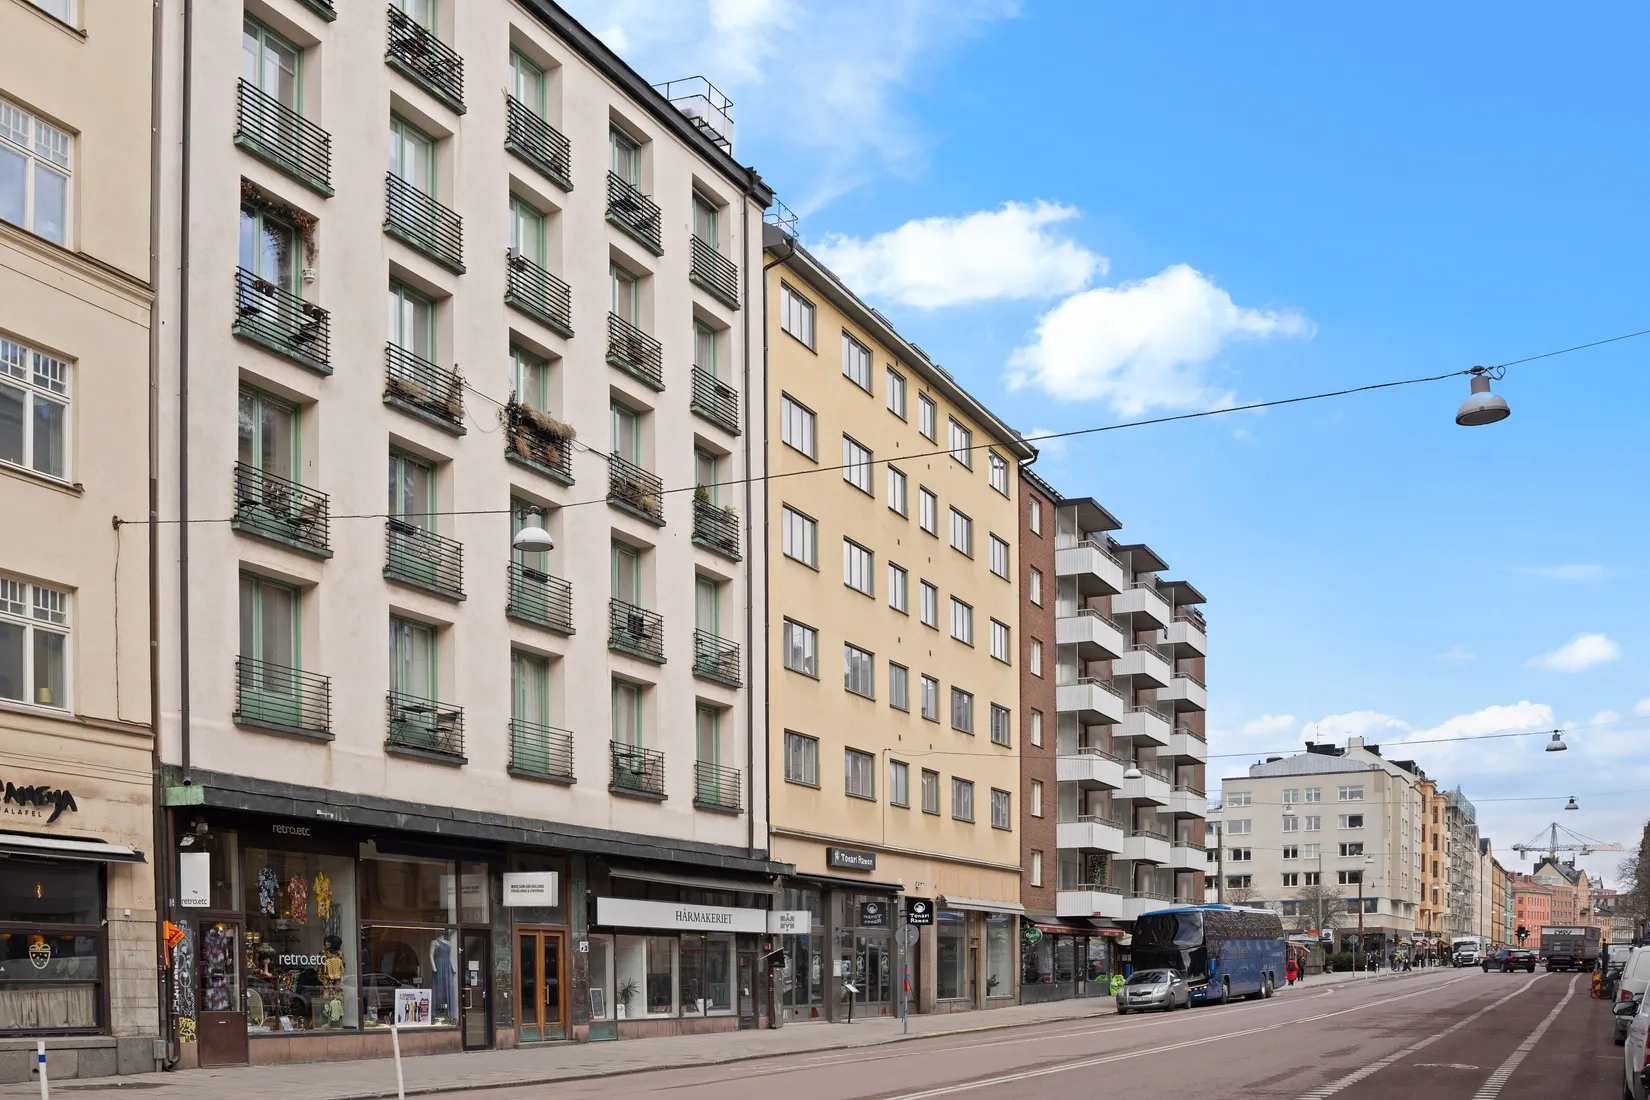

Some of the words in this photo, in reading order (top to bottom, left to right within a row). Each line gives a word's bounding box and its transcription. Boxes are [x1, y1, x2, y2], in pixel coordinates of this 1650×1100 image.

[272, 824, 311, 837] retro.etc
[841, 853, 858, 863] Tonari
[181, 898, 208, 906] retro.etc
[675, 908, 733, 924] HÅRMAKERIET
[279, 953, 326, 965] retro.etc
